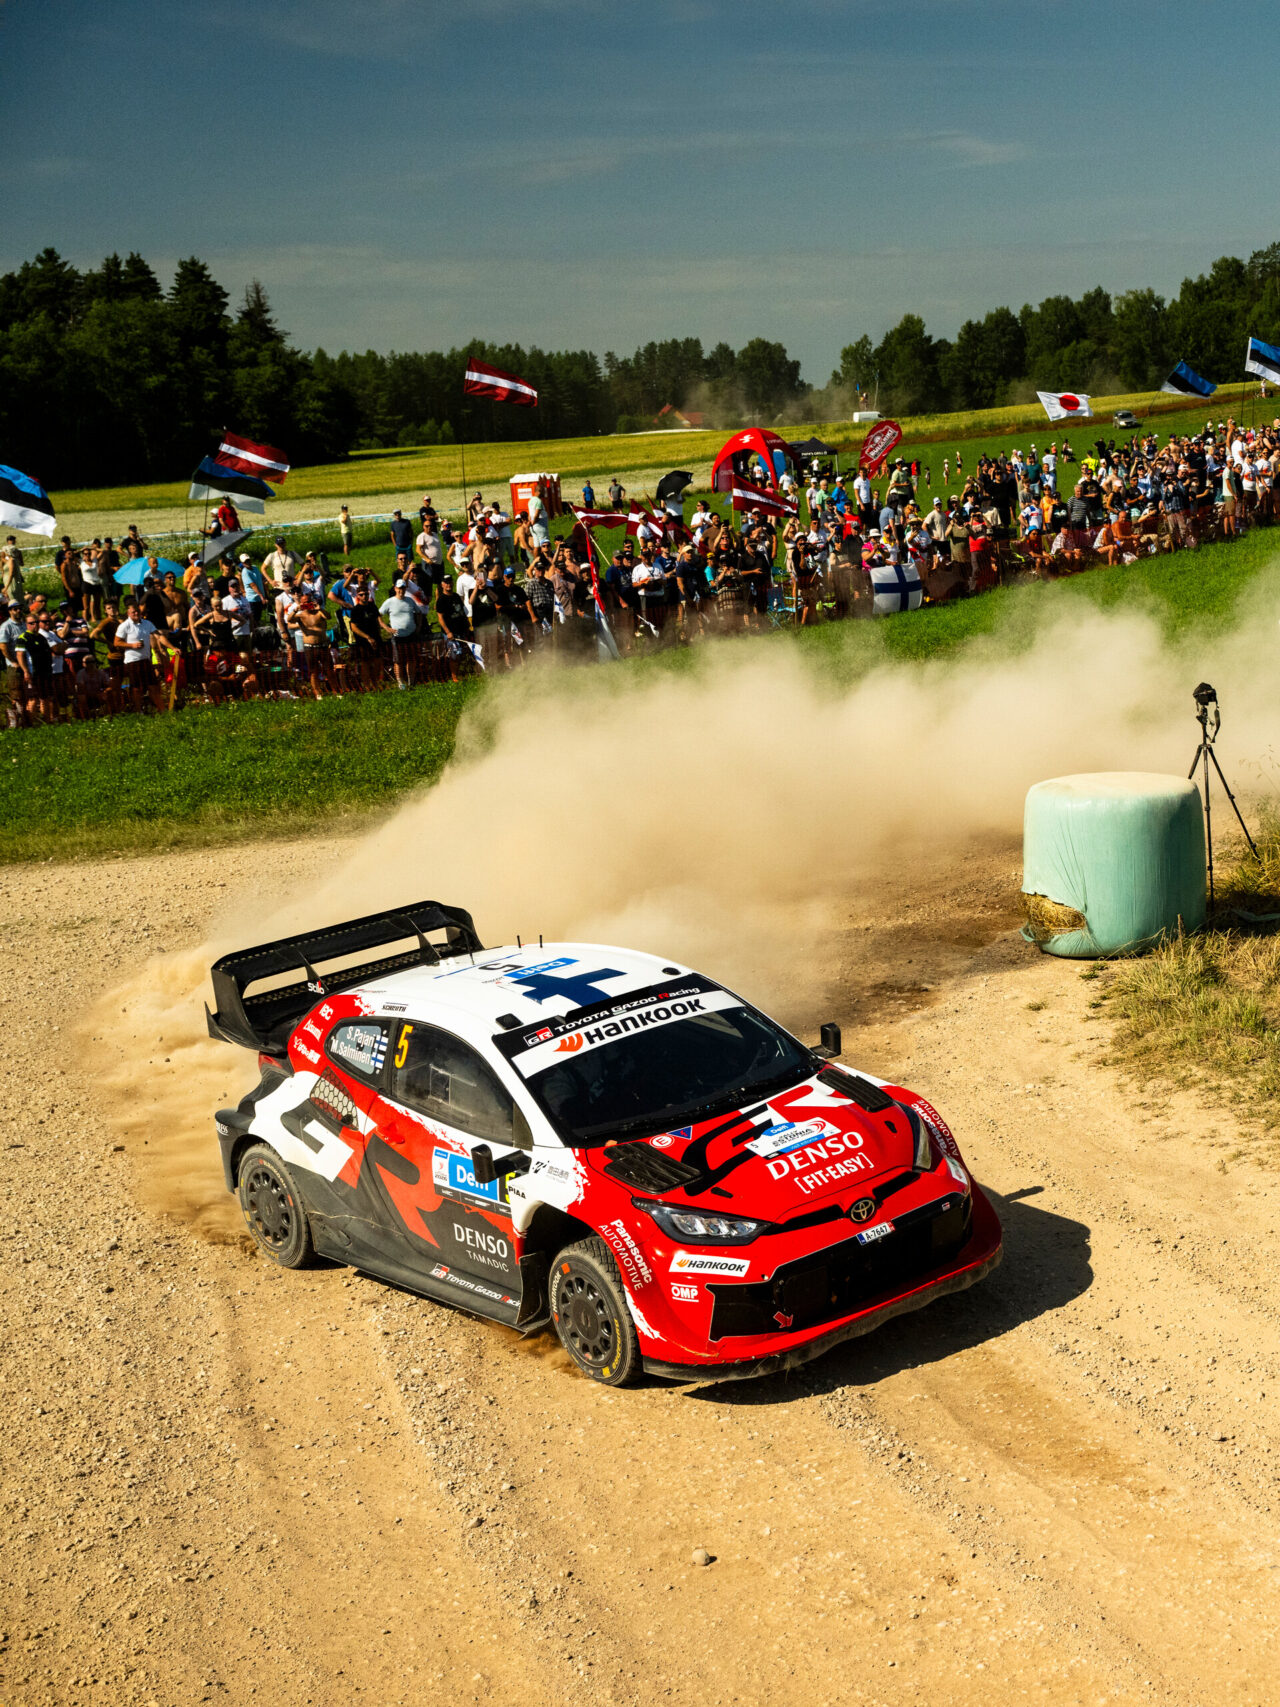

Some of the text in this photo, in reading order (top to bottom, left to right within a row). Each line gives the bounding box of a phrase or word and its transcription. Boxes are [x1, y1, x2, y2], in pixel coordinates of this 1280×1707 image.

[554, 1010, 611, 1034] TOYOTA
[611, 996, 658, 1014] GAZOO
[658, 987, 701, 1000] Racing
[330, 1038, 371, 1065] M.Salminen
[346, 1025, 376, 1048] S.Pajari
[394, 1023, 414, 1069] 5
[770, 1124, 789, 1134] Delfi
[917, 1099, 959, 1157] AUTOMOTIVE
[765, 1131, 864, 1181] DENSO
[507, 1185, 527, 1199] PIAA
[453, 1222, 508, 1258] DENSO
[865, 1224, 888, 1241] A-7647
[598, 1224, 644, 1291] AUTOMOTIVE
[610, 1218, 653, 1284] Panasonic
[446, 1273, 475, 1290] TOYOTA
[474, 1285, 502, 1300] GAZOO
[671, 1286, 699, 1299] OMP
